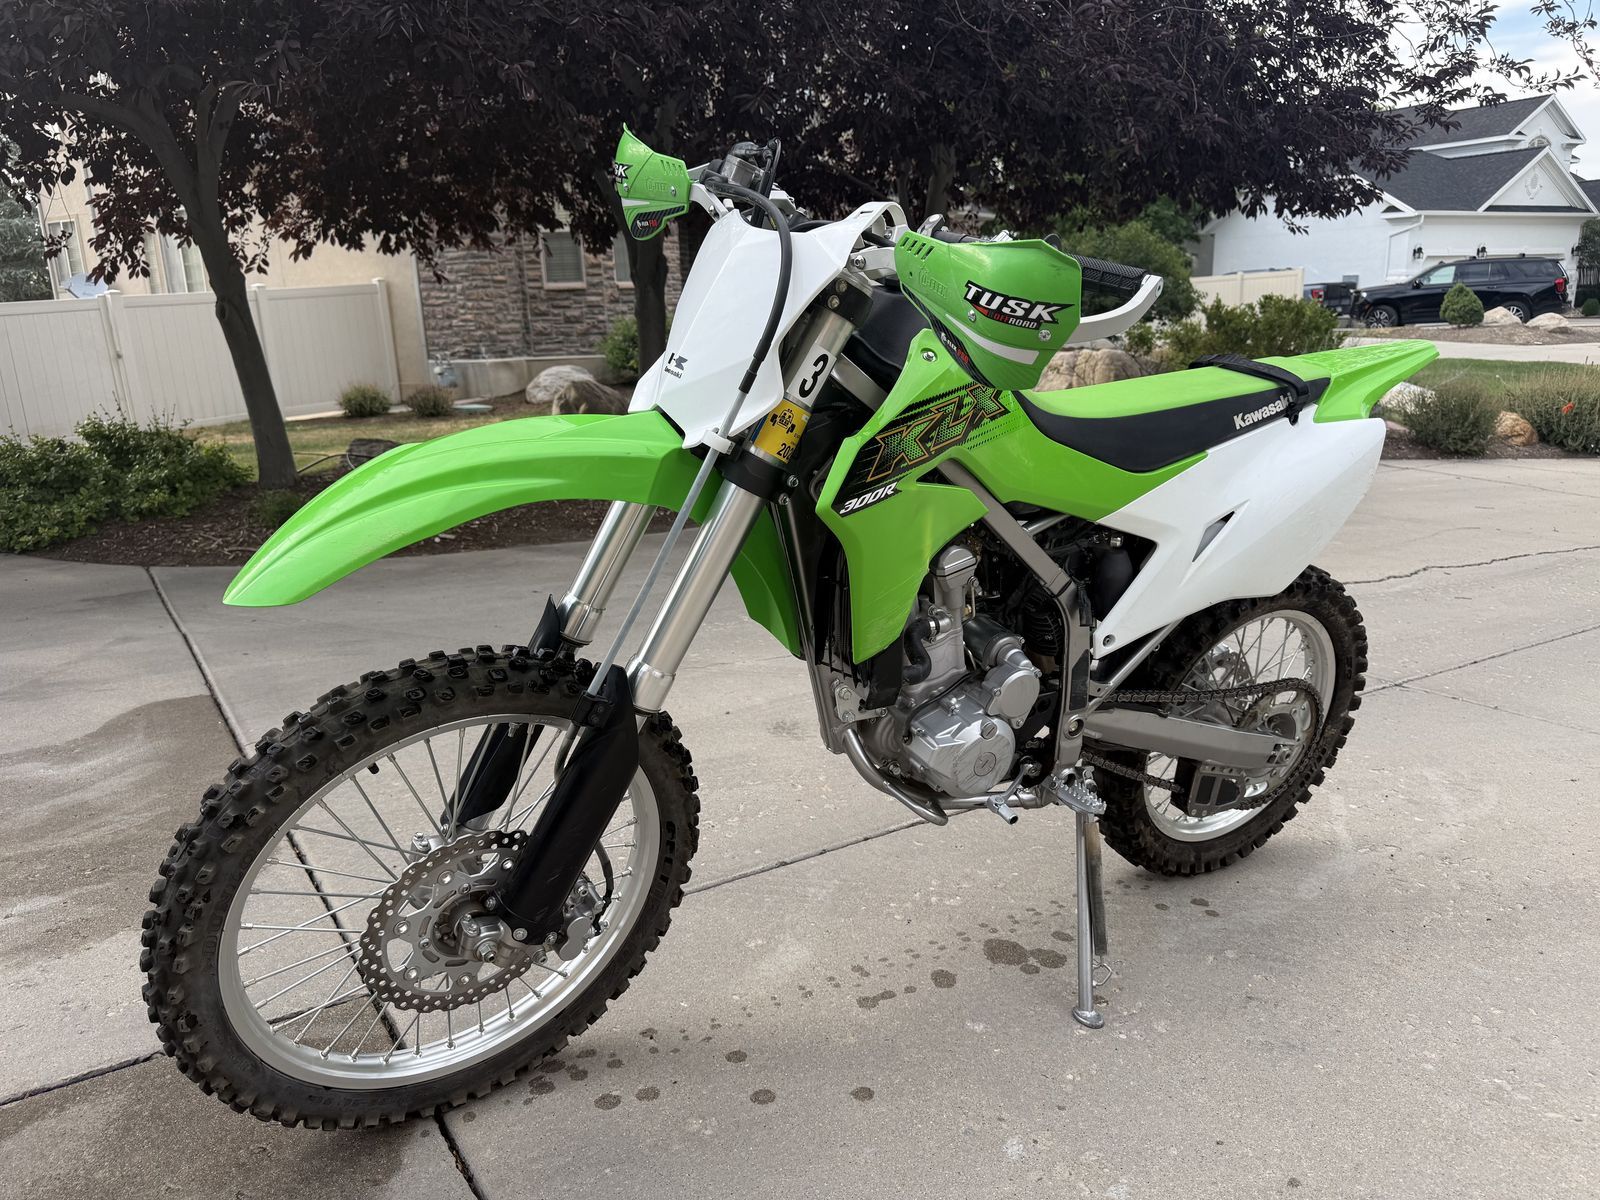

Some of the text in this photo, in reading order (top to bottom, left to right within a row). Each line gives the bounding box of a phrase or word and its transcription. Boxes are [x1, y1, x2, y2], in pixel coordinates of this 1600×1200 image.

[966, 283, 1062, 322] TUSK
[798, 353, 829, 398] 3
[1233, 392, 1293, 430] Kawasaki
[839, 481, 898, 515] 300R
